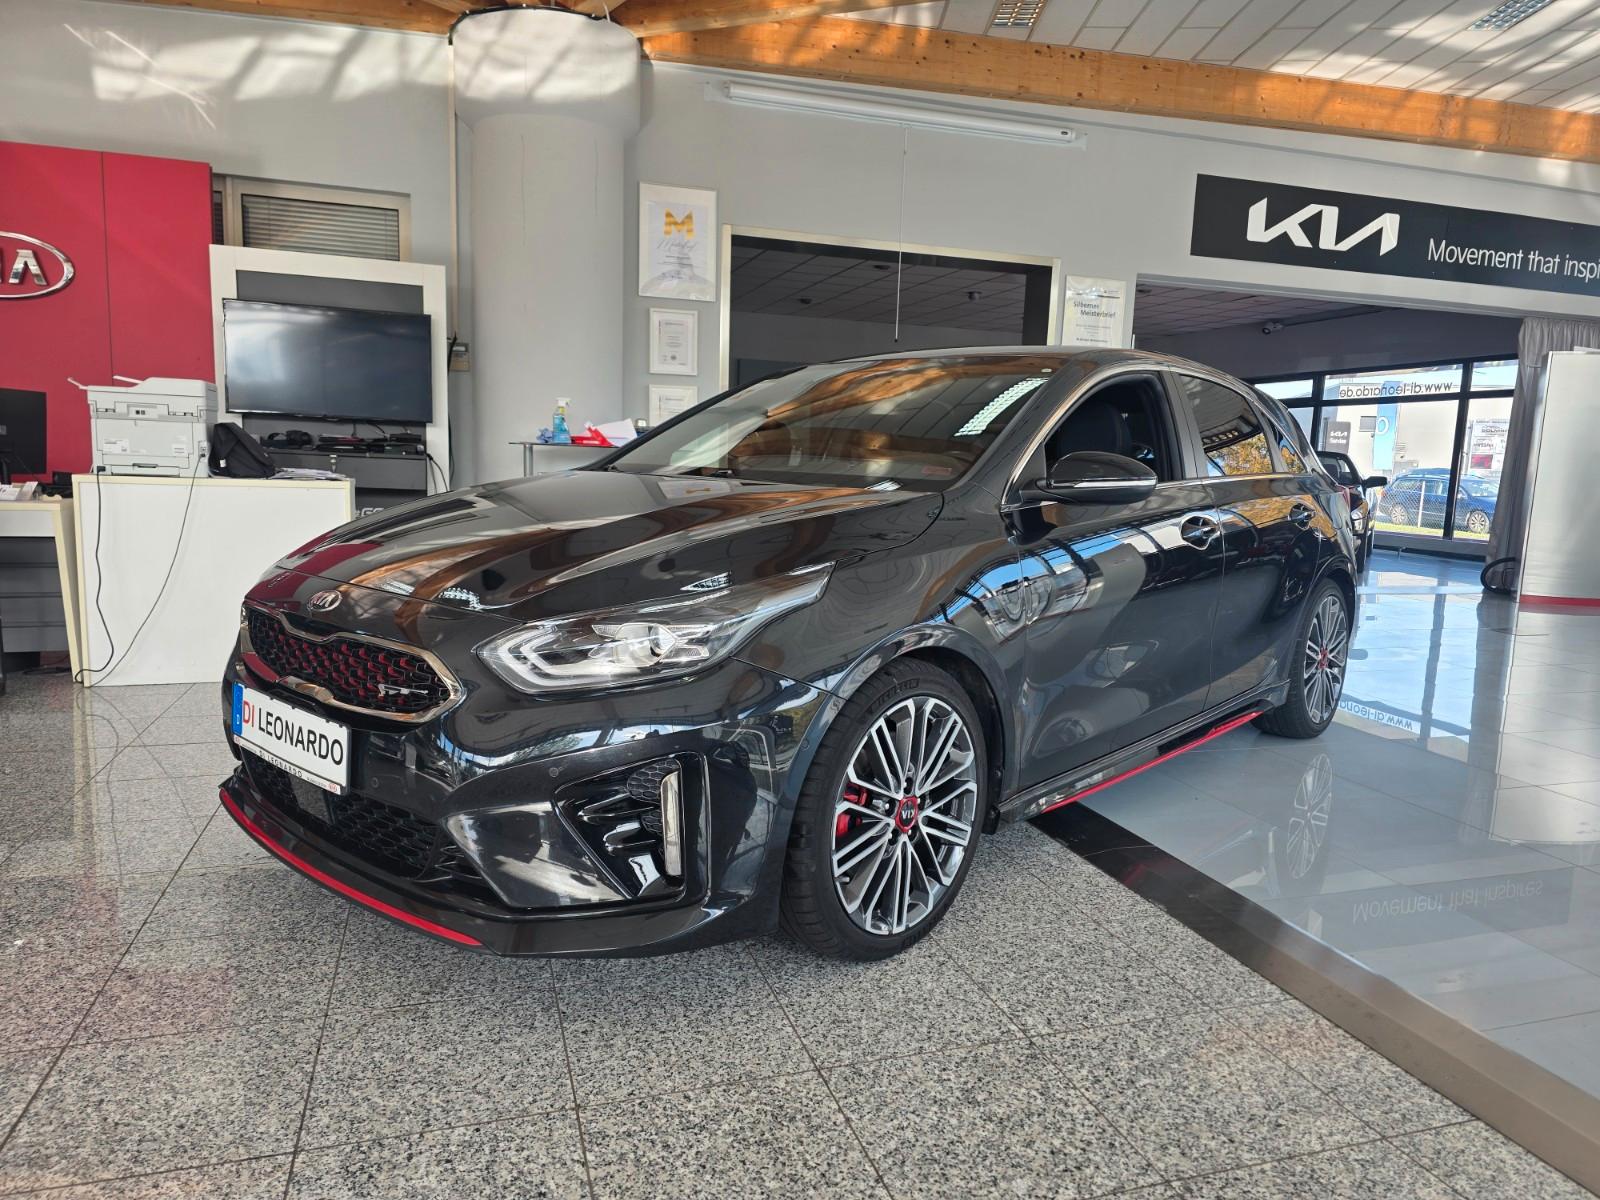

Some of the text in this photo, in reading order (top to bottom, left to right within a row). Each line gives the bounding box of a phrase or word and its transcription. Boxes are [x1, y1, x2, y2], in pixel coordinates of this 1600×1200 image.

[1246, 197, 1400, 256] KIA
[1427, 237, 1524, 271] Movement
[1527, 249, 1561, 275] that
[242, 699, 344, 766] DI LEONARDO
